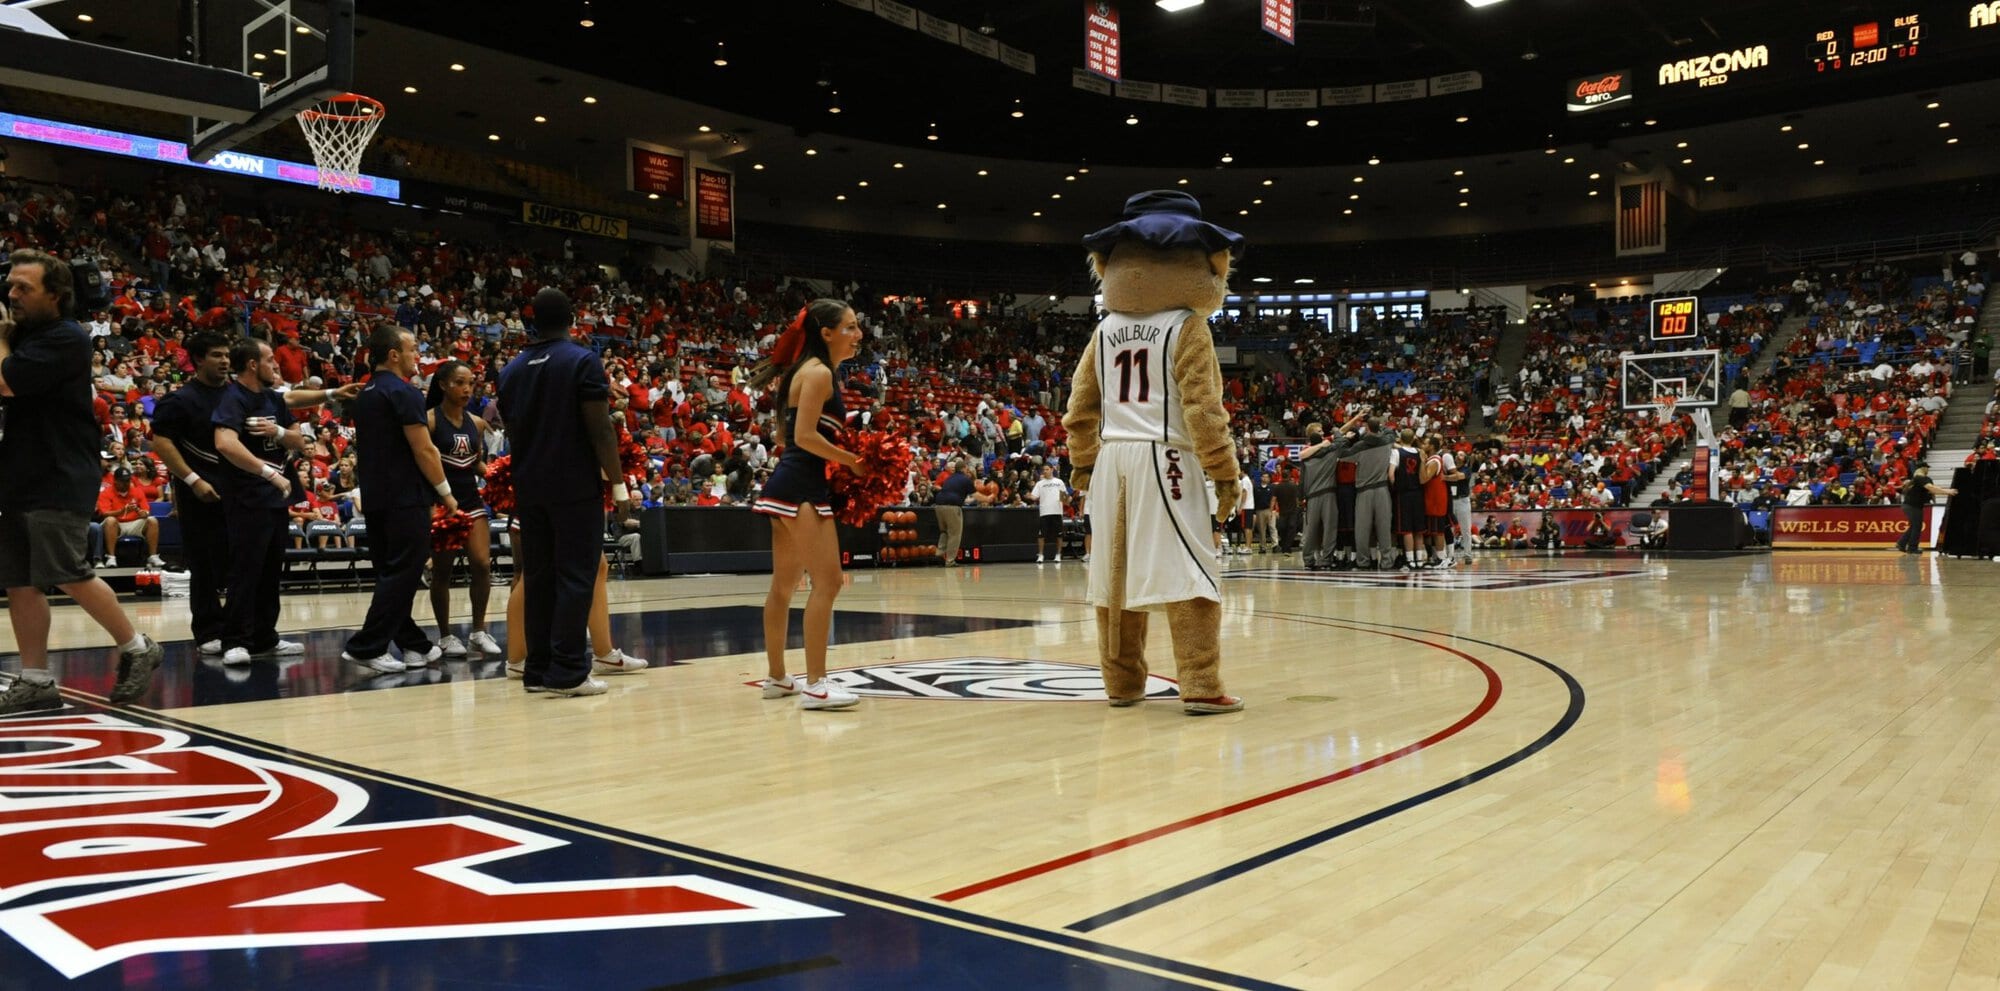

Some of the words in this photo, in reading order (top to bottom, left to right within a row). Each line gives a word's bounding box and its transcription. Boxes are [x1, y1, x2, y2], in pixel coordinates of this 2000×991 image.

[1089, 14, 1117, 32] ARIZONA
[1894, 14, 1919, 28] BLUE
[1089, 29, 1108, 42] SWEET
[1816, 30, 1834, 42] RED
[1908, 25, 1920, 41] 0
[1826, 41, 1838, 55] 0
[1850, 47, 1888, 67] 12:00
[1659, 45, 1768, 86] ARIZONA
[1699, 74, 1728, 88] RED
[649, 156, 669, 168] WAC
[444, 196, 488, 211] verion
[527, 203, 621, 236] SUPERCUTS
[1660, 301, 1693, 316] 12:00
[1662, 316, 1687, 335] 00
[1107, 324, 1161, 348] WILBUR
[1114, 348, 1150, 404] 11
[451, 433, 472, 456] A
[1165, 449, 1183, 501] CATS
[1778, 520, 1850, 534] WELLS
[1854, 520, 1926, 534] FARG
